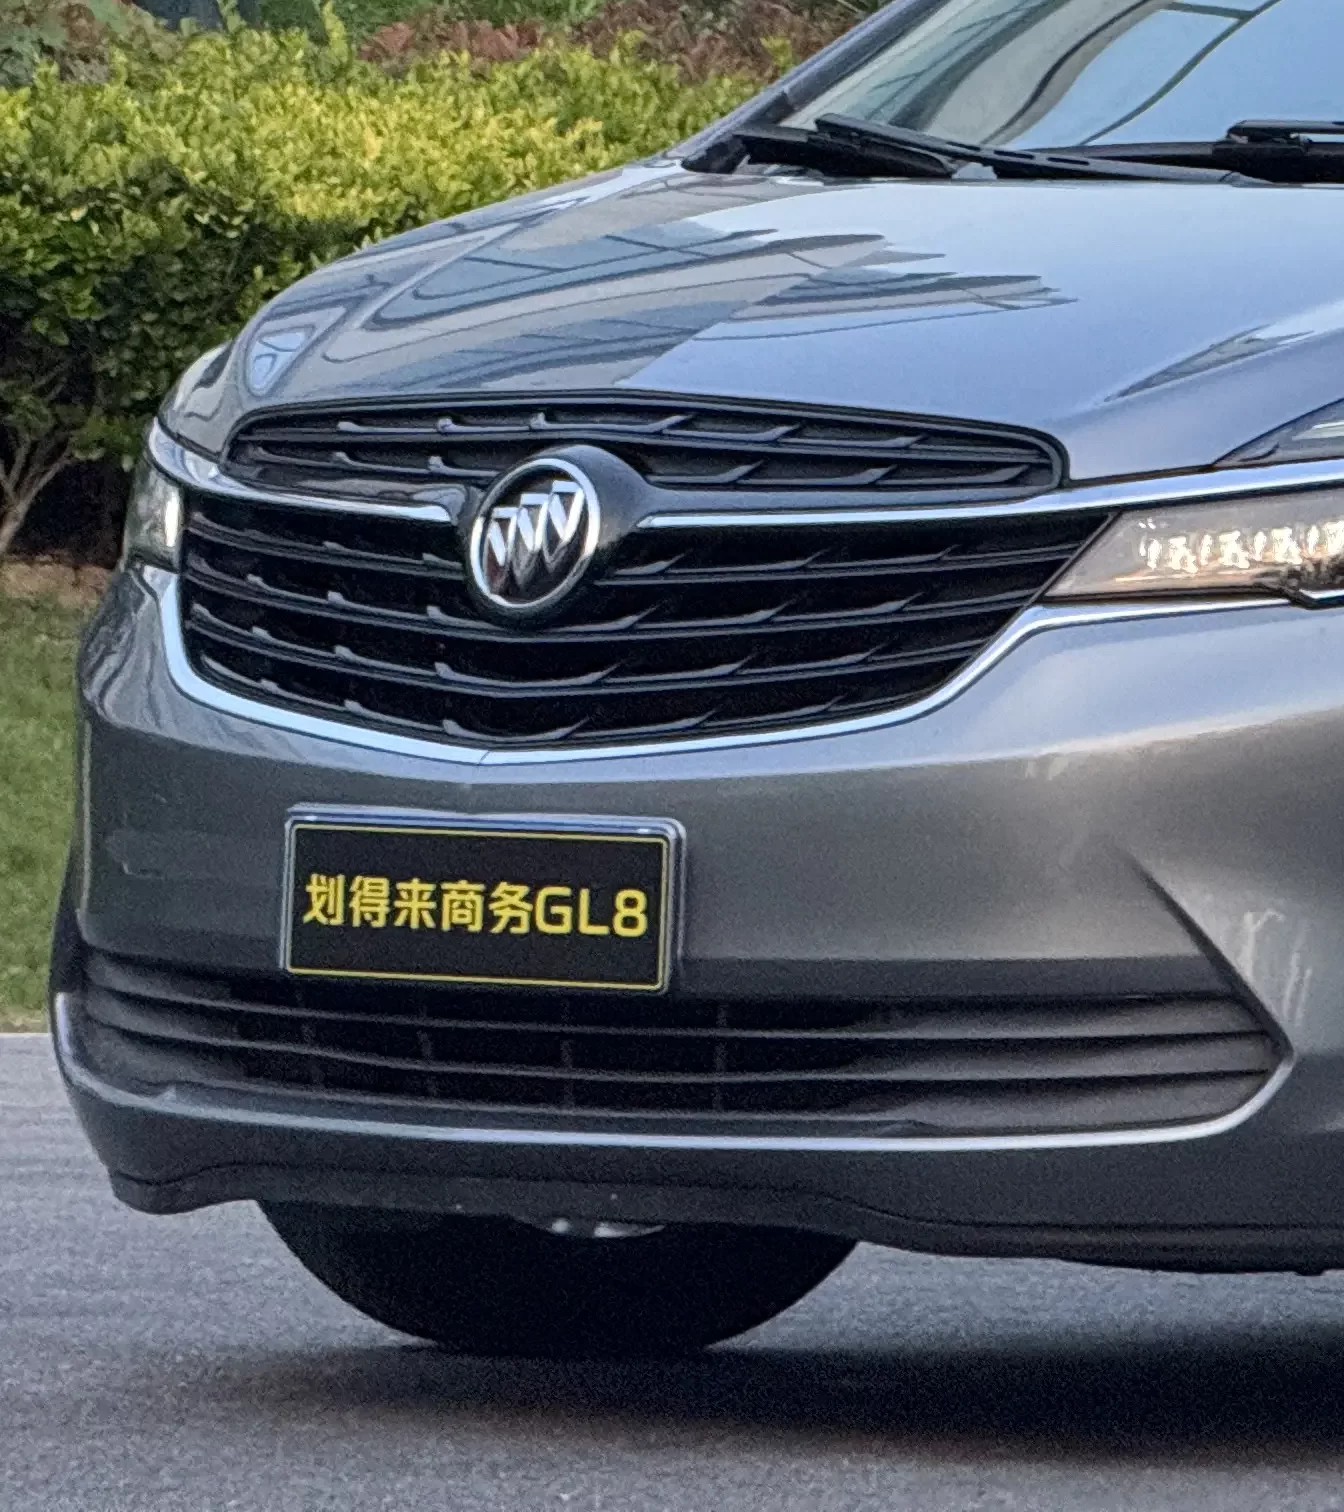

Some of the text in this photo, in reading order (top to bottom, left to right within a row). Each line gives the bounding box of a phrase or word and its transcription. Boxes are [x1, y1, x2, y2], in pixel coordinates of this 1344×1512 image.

[303, 874, 648, 938] 划得来商务GL8
